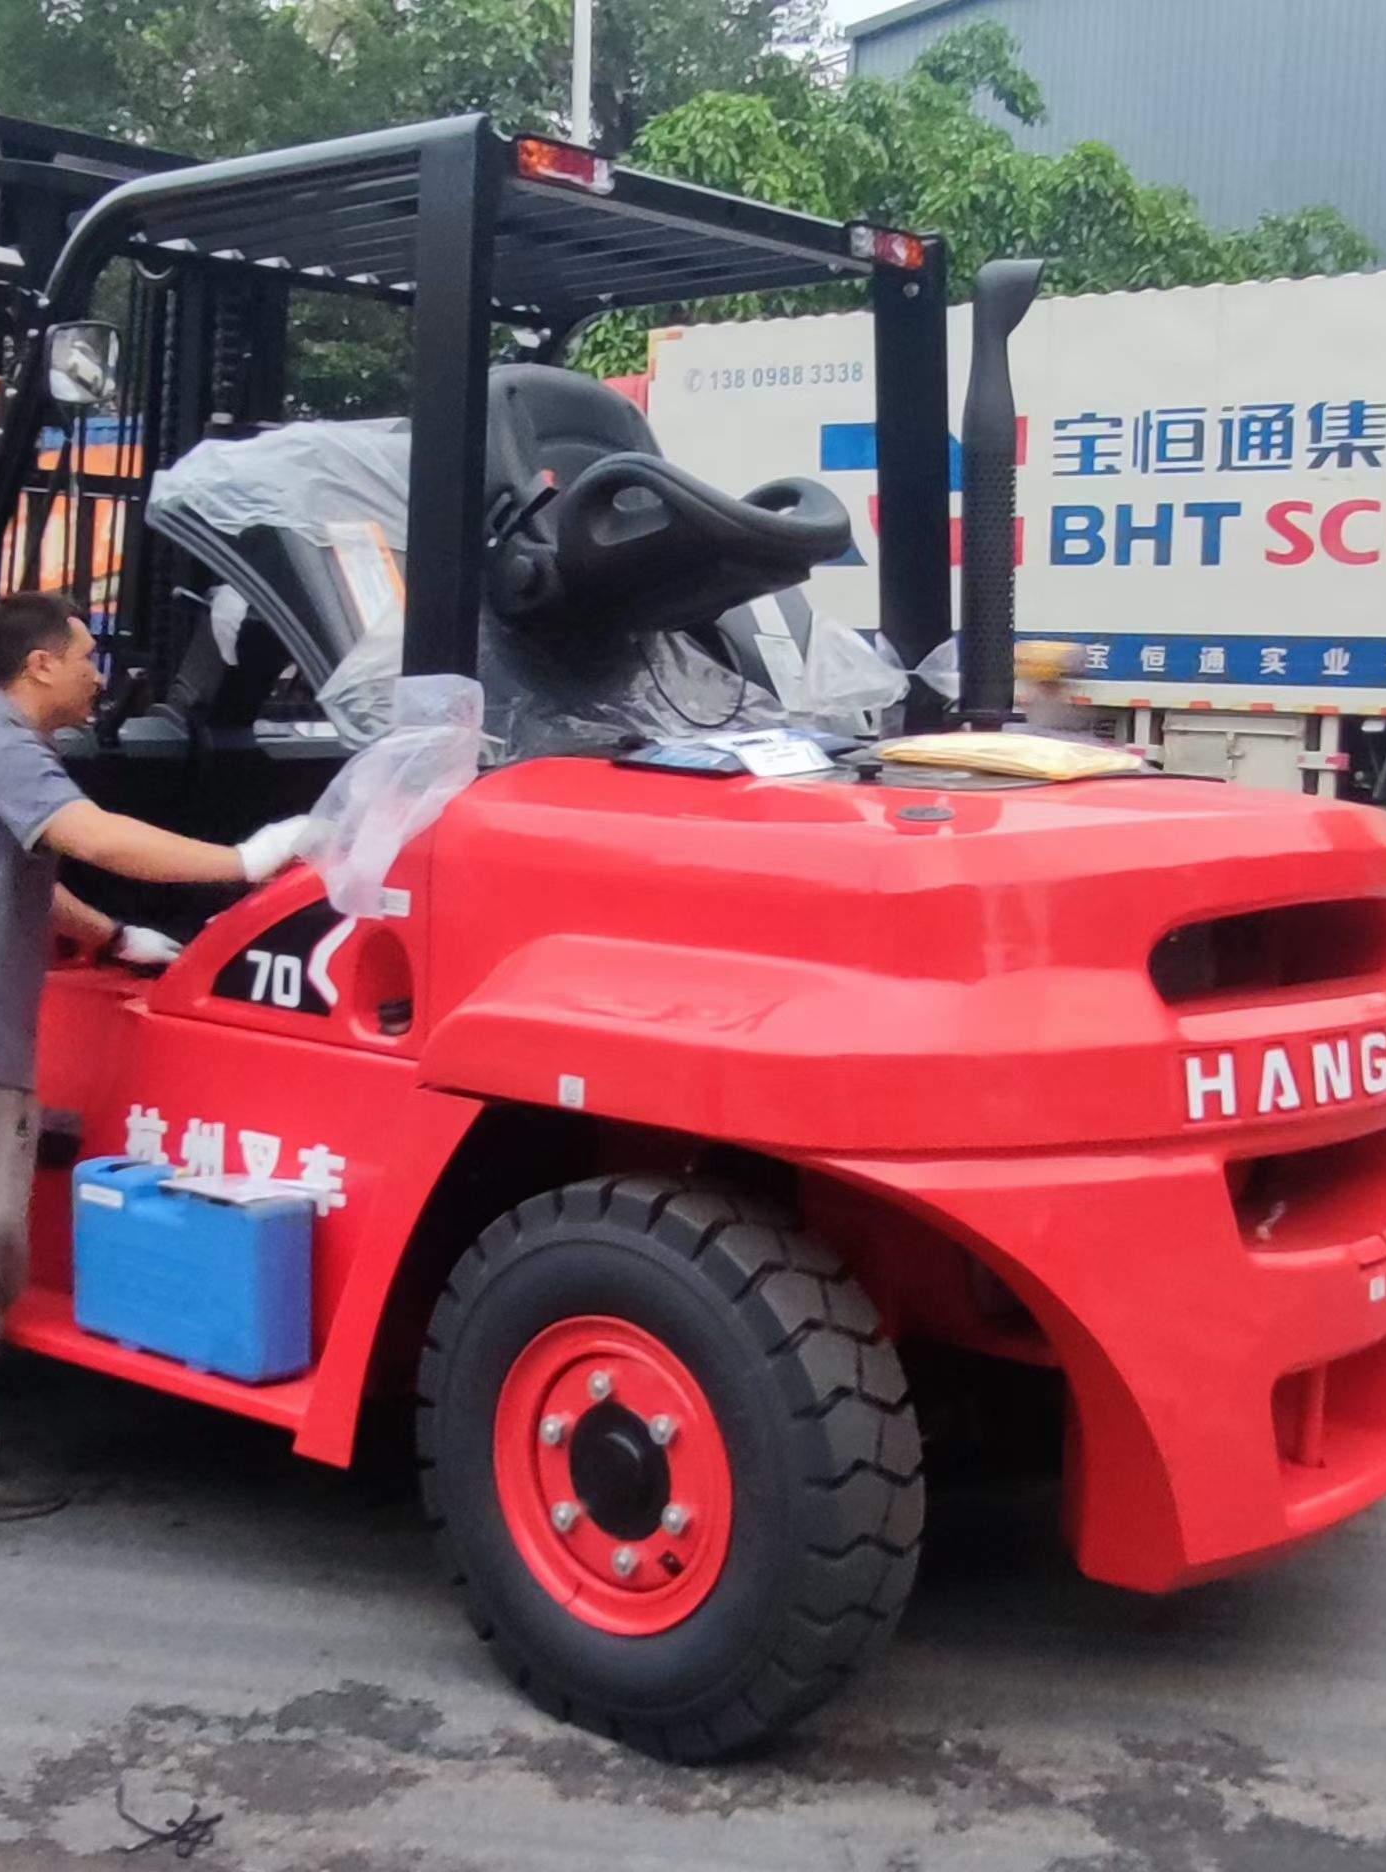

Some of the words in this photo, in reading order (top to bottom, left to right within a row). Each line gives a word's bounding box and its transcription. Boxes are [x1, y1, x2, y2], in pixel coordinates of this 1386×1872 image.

[710, 369, 745, 390] 138
[752, 366, 803, 388] 0988
[809, 361, 863, 384] 3338
[1049, 502, 1242, 566] BHT
[246, 949, 303, 1009] 70
